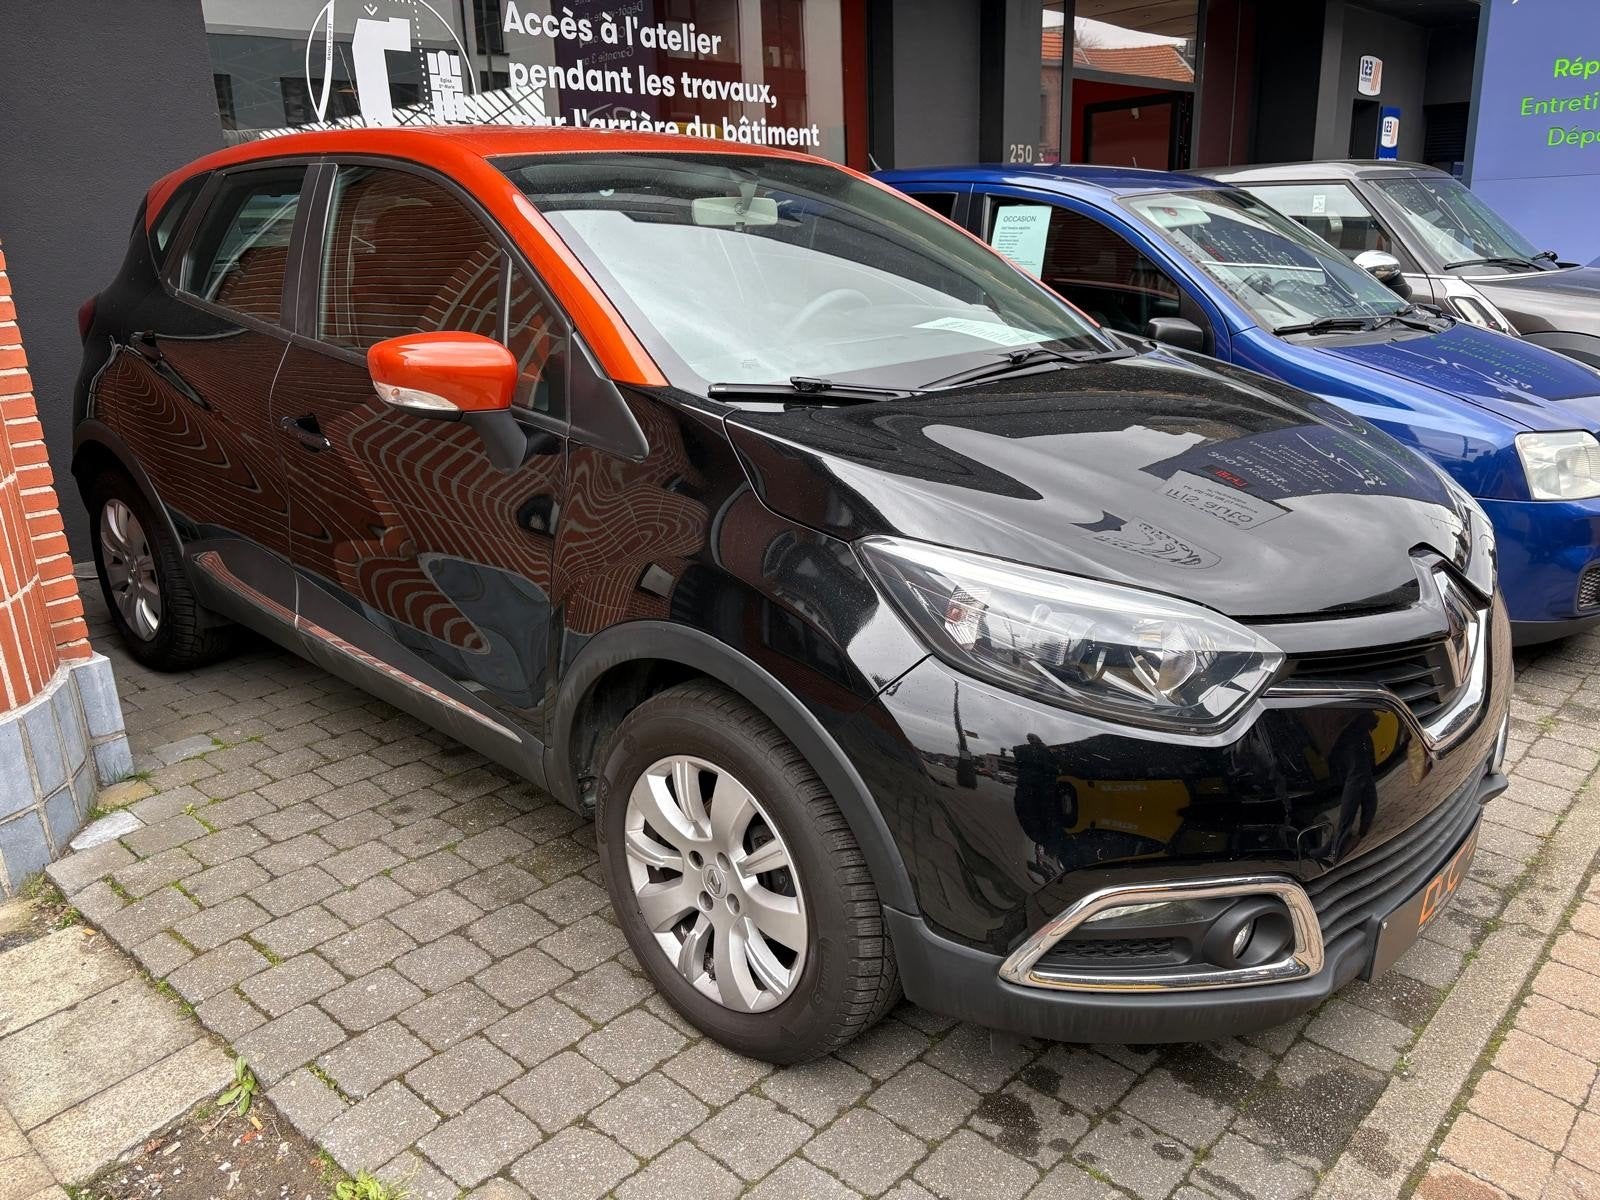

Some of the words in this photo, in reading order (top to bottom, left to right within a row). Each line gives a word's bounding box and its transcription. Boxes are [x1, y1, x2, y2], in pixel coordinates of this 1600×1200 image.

[503, 1, 593, 43] Accès
[600, 11, 619, 45] à
[625, 16, 722, 55] l'atelier
[1361, 58, 1373, 77] 123
[509, 60, 633, 95] pendant
[638, 65, 676, 98] les
[680, 72, 777, 110] travaux,
[1520, 91, 1600, 116] Entreti
[686, 115, 717, 139] du
[723, 116, 820, 147] bâtiment
[1547, 125, 1600, 149] Dép
[1009, 143, 1033, 164] 250
[1003, 215, 1037, 223] OCCASION
